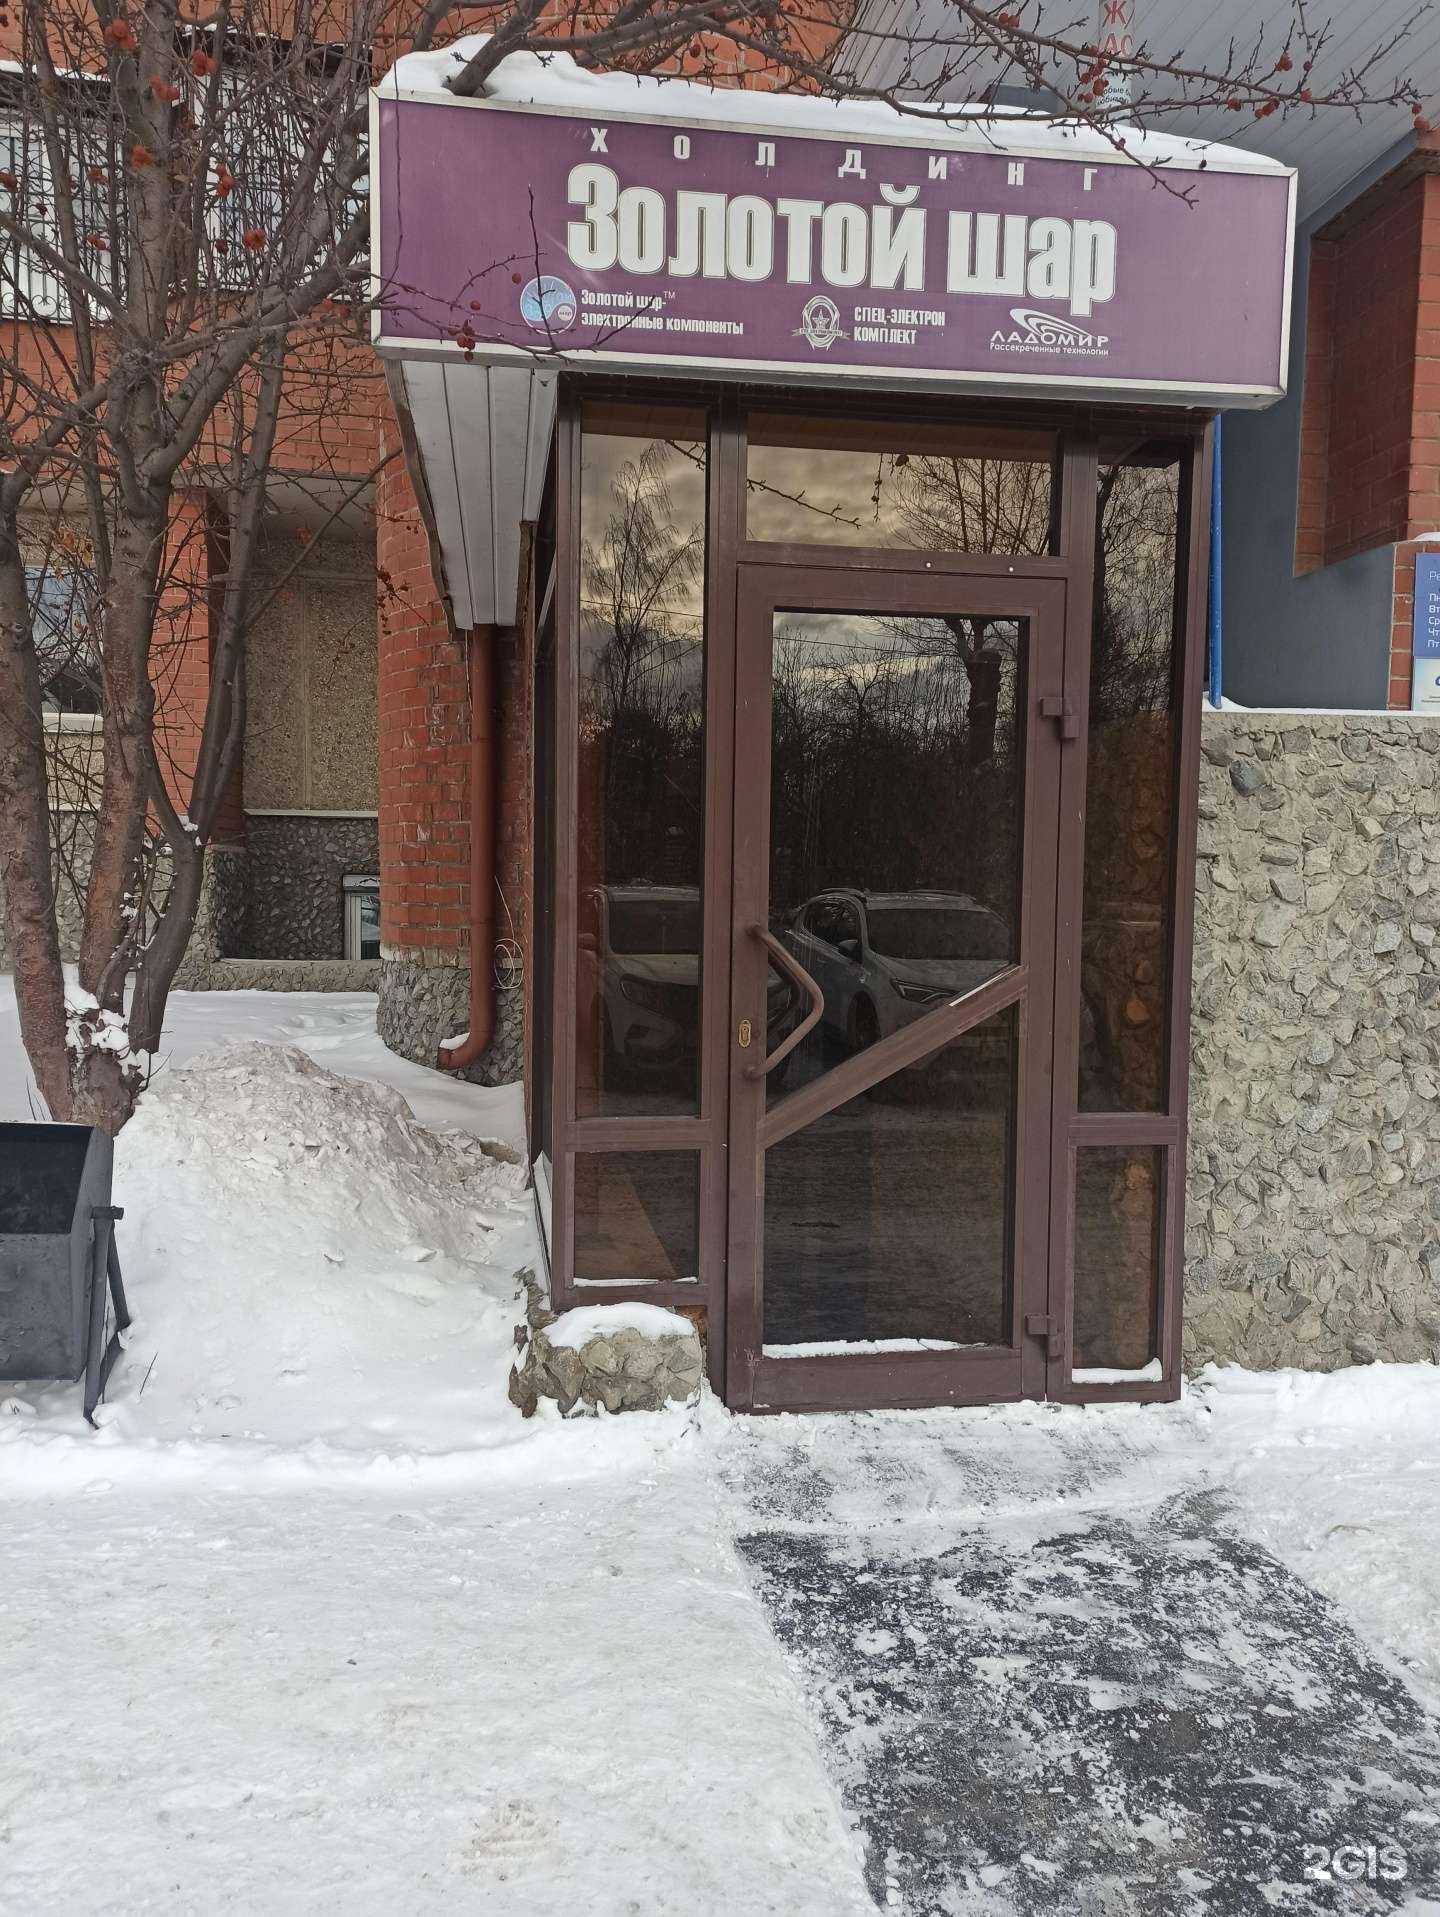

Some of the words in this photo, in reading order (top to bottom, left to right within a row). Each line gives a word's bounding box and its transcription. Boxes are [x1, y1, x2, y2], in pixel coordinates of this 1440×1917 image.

[589, 126, 1098, 192] ХОЛДИНГ
[567, 162, 927, 292] Золотой
[946, 209, 1118, 318] шар
[581, 289, 634, 309] Золотой
[581, 312, 664, 330] электронные
[666, 317, 744, 335] компоненты
[854, 306, 946, 326] СПЕЦ-ЭЛЕКТРОН
[853, 326, 917, 345] КОМПЛЕКТ
[990, 330, 1109, 348] ЛАДОМИР
[989, 342, 1061, 355] Рассекреченные
[1063, 346, 1109, 357] технологии
